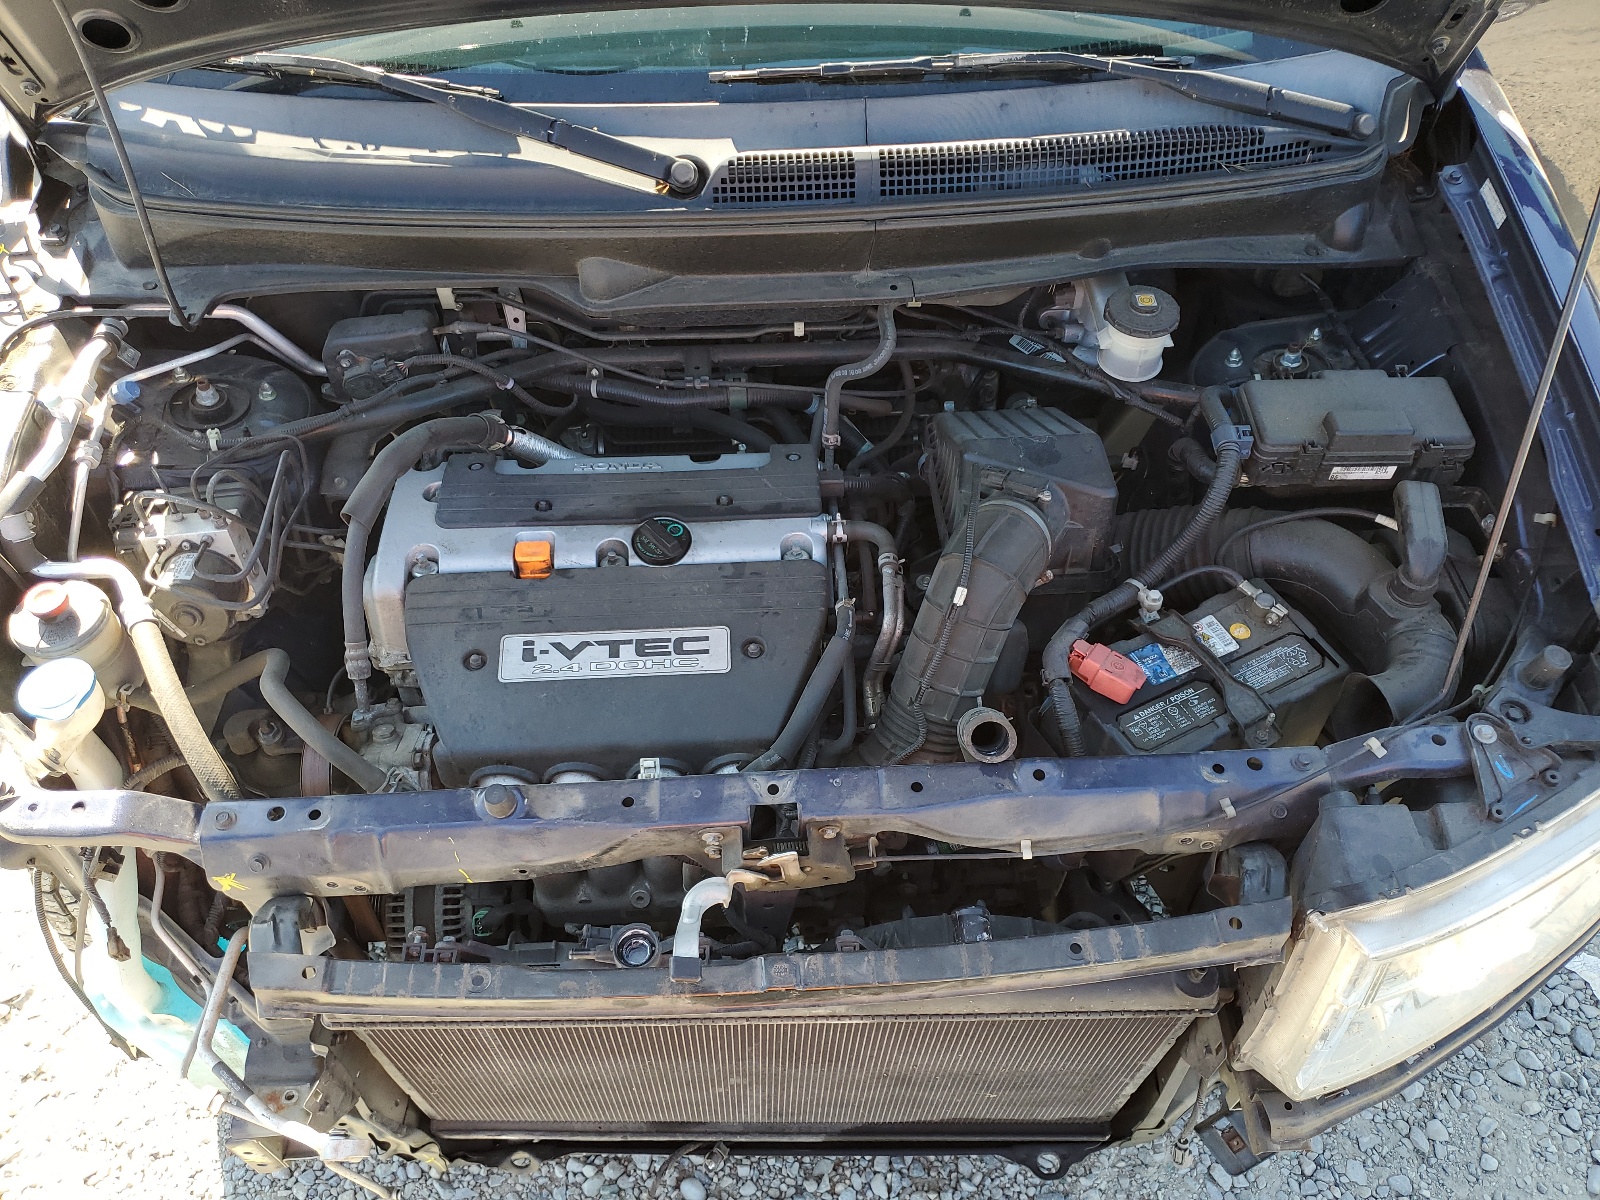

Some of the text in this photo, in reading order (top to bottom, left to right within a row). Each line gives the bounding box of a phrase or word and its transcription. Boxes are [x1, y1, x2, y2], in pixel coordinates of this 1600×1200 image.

[573, 461, 662, 472] HONDA
[521, 635, 710, 663] i-VTEC
[532, 657, 700, 675] 2.4 DOHC
[1139, 701, 1167, 717] DANGER
[1170, 688, 1195, 702] POISON
